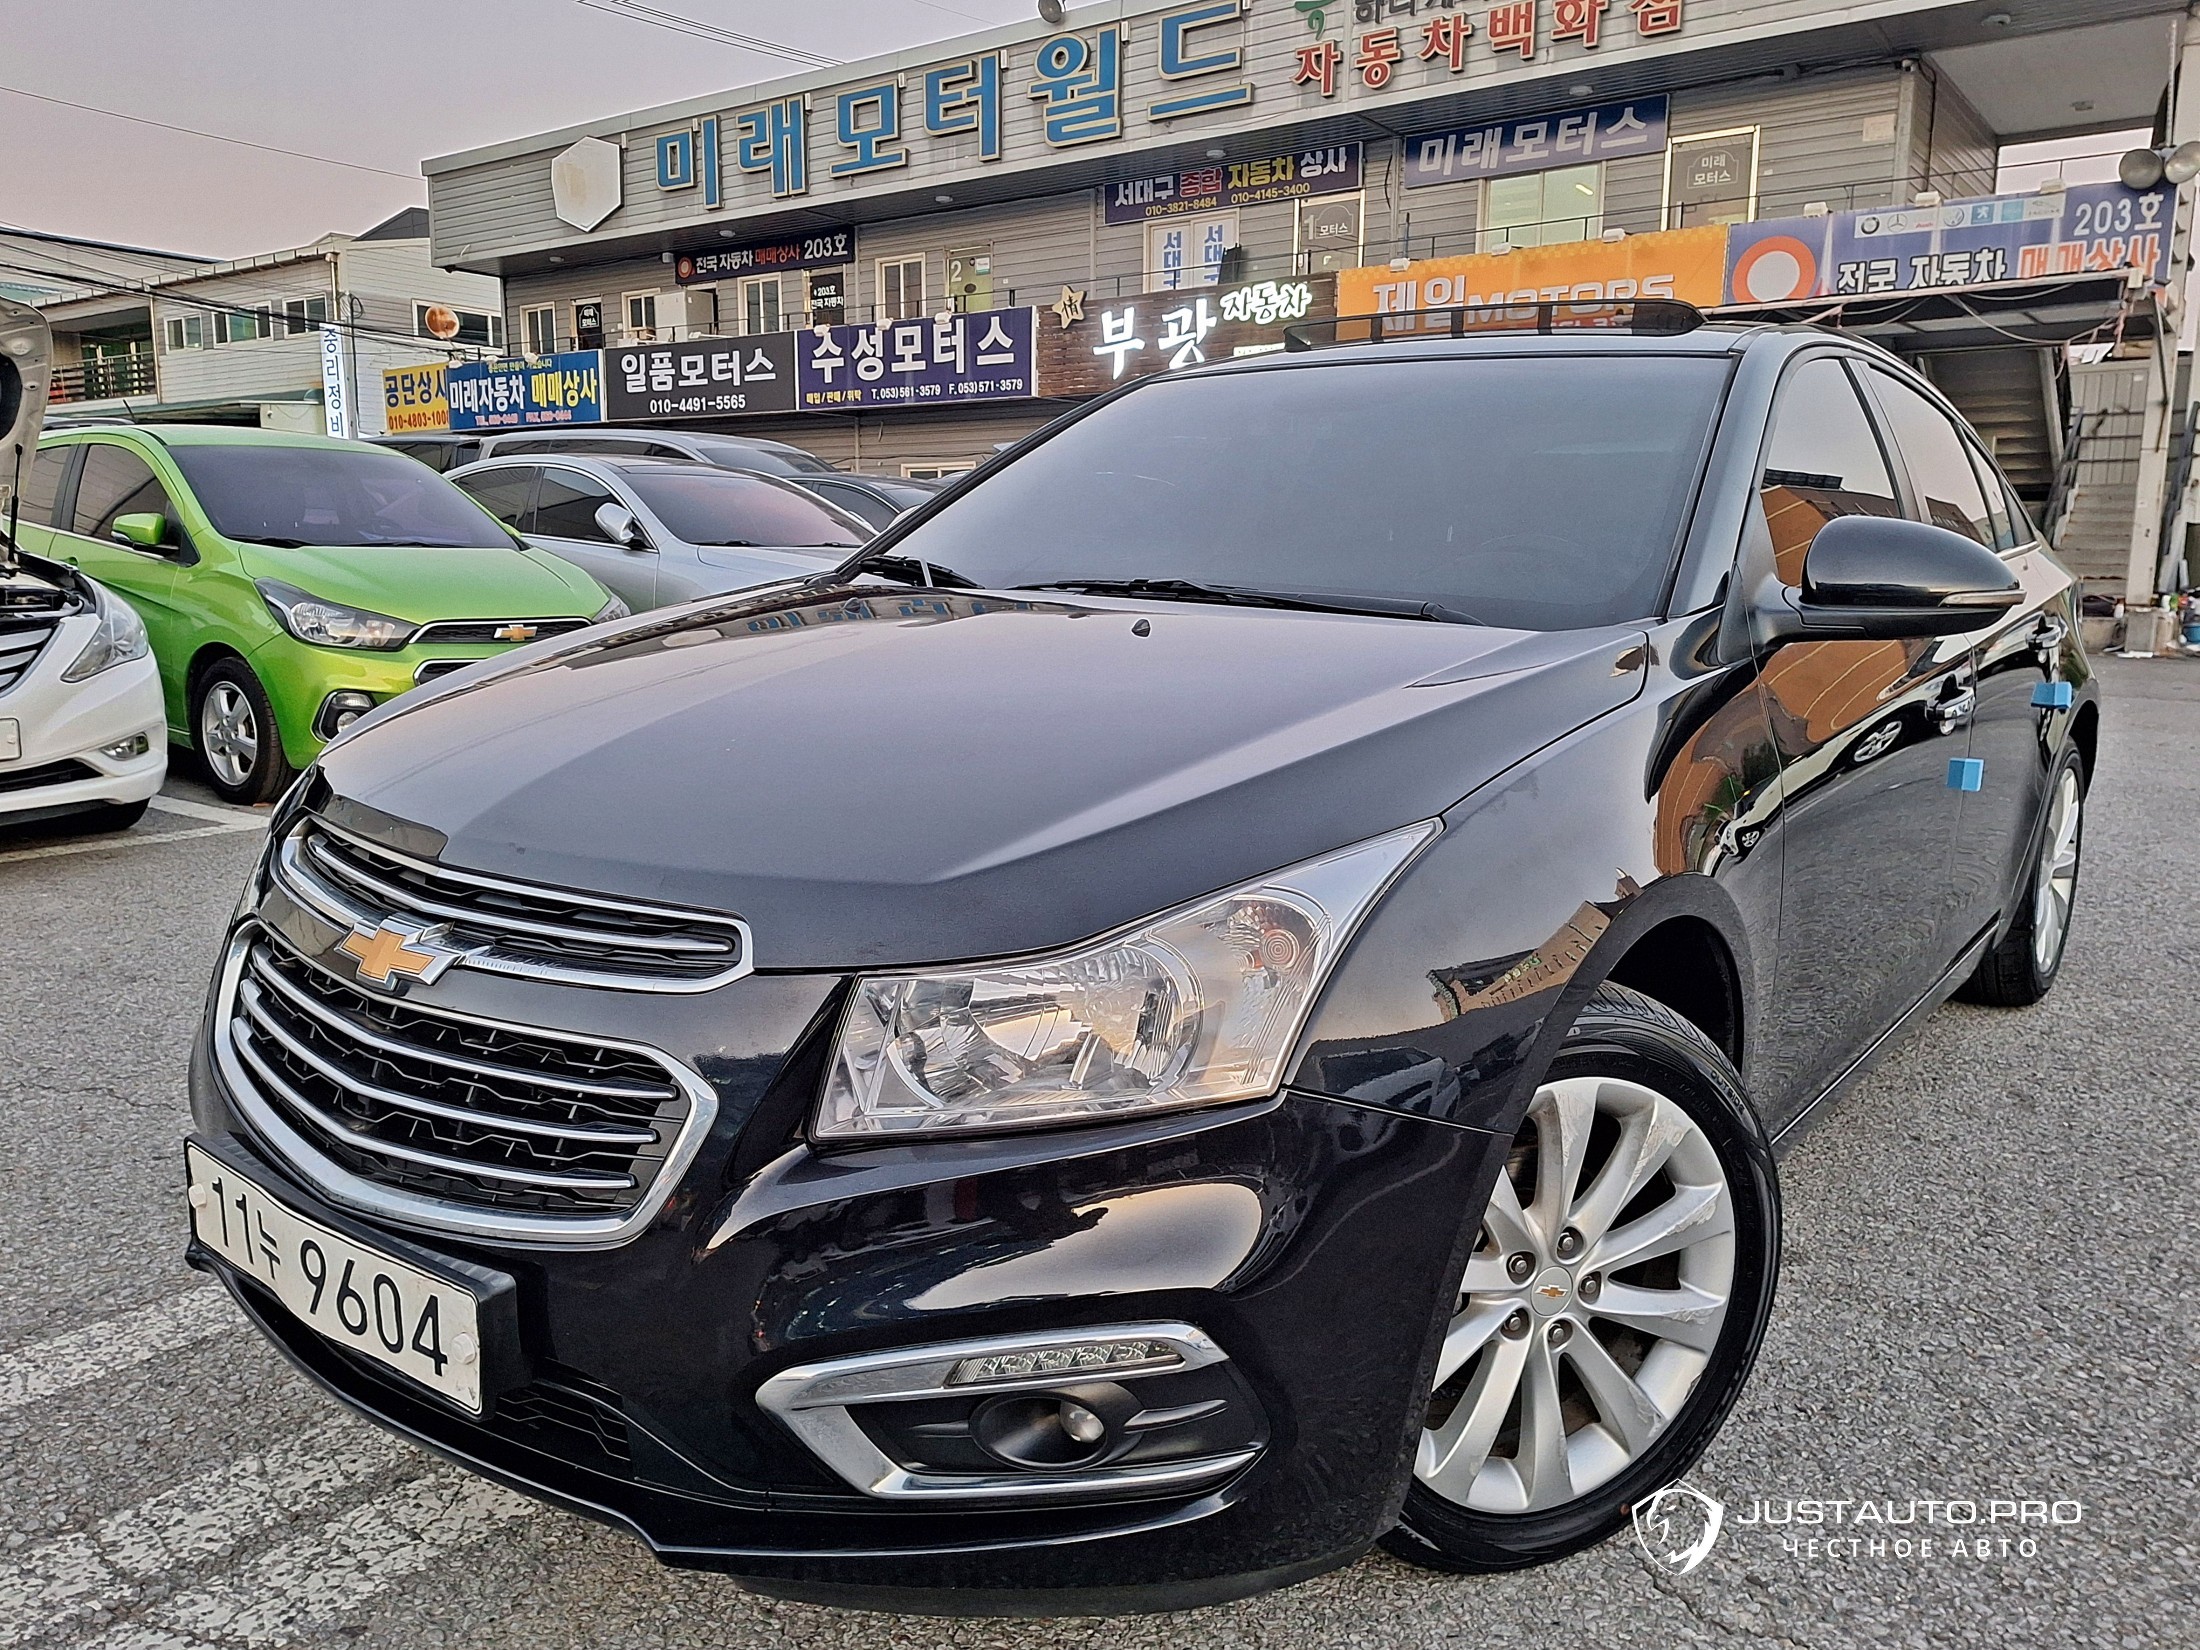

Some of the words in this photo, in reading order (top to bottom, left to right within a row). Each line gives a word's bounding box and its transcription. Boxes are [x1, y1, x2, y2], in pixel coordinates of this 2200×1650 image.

[1418, 106, 1648, 176] 미래모터스
[1701, 154, 1726, 169] 미래
[1115, 175, 1174, 207] 서대구
[1179, 167, 1222, 198] 종합
[1228, 156, 1294, 190] 자동차
[1300, 147, 1347, 179] 상사
[1693, 170, 1731, 186] 모터스
[1145, 196, 1217, 217] 010-3821-8484
[1230, 183, 1310, 204] 010-4145-3400
[2073, 192, 2164, 236] 203호
[1319, 222, 1349, 236] 모터스
[696, 254, 718, 275] 전국
[719, 249, 754, 271] 자동차
[754, 243, 800, 266] 매매상사
[803, 233, 848, 260] 203호
[950, 260, 962, 283] 2
[1909, 248, 2006, 289] 자동차
[817, 285, 837, 297] 203호
[1219, 281, 1312, 325] 자동차
[621, 347, 777, 393] 일품모터스
[811, 315, 1016, 384] 수성모터스
[323, 328, 344, 437] 중리정비
[450, 373, 526, 414] 미래자동차
[530, 367, 597, 409] 매매상사
[649, 394, 746, 415] 010-4491-5565
[211, 1176, 281, 1281] 11누
[299, 1238, 449, 1378] 9604
